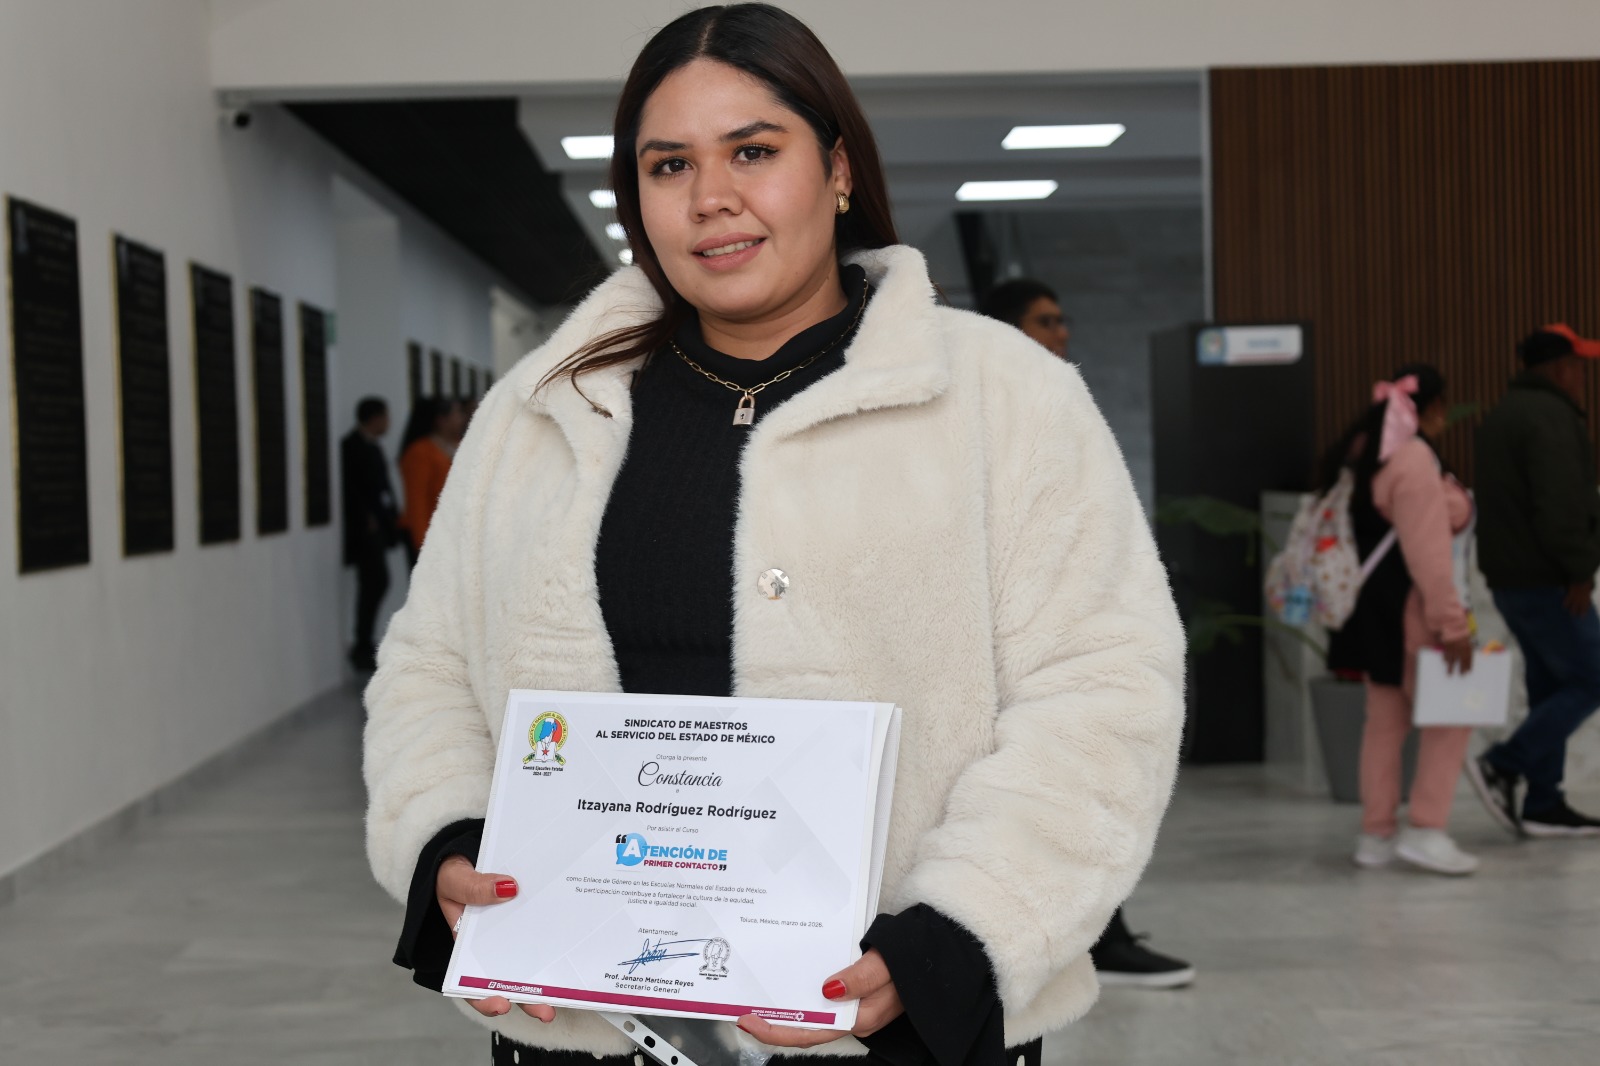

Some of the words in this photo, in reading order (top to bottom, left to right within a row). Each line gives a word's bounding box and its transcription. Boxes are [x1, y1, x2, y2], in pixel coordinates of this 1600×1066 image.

[624, 719, 676, 728] SINDICATO
[678, 720, 692, 729] DE
[694, 721, 748, 730] MAESTROS
[596, 730, 608, 738] AL
[610, 730, 656, 740] SERVICIO
[658, 732, 676, 740] DEL
[679, 732, 718, 742] ESTADO
[720, 734, 734, 742] DE
[736, 732, 776, 744] MÉXICO
[638, 761, 723, 786] Constancia
[578, 799, 632, 814] Itzayana
[636, 802, 703, 816] Rodríguez
[708, 804, 776, 820] Rodríguez
[708, 849, 728, 861] DE
[644, 860, 673, 868] PRIMER
[676, 882, 703, 890] Normales
[584, 886, 620, 896] participación
[621, 889, 651, 898] contribuye
[657, 892, 685, 900] fortalecer
[654, 899, 679, 908] igualdad
[638, 928, 678, 936] Atentamente
[645, 976, 673, 985] Martínez
[675, 979, 694, 987] Reyes
[615, 982, 650, 991] Secretario
[653, 985, 680, 994] General
